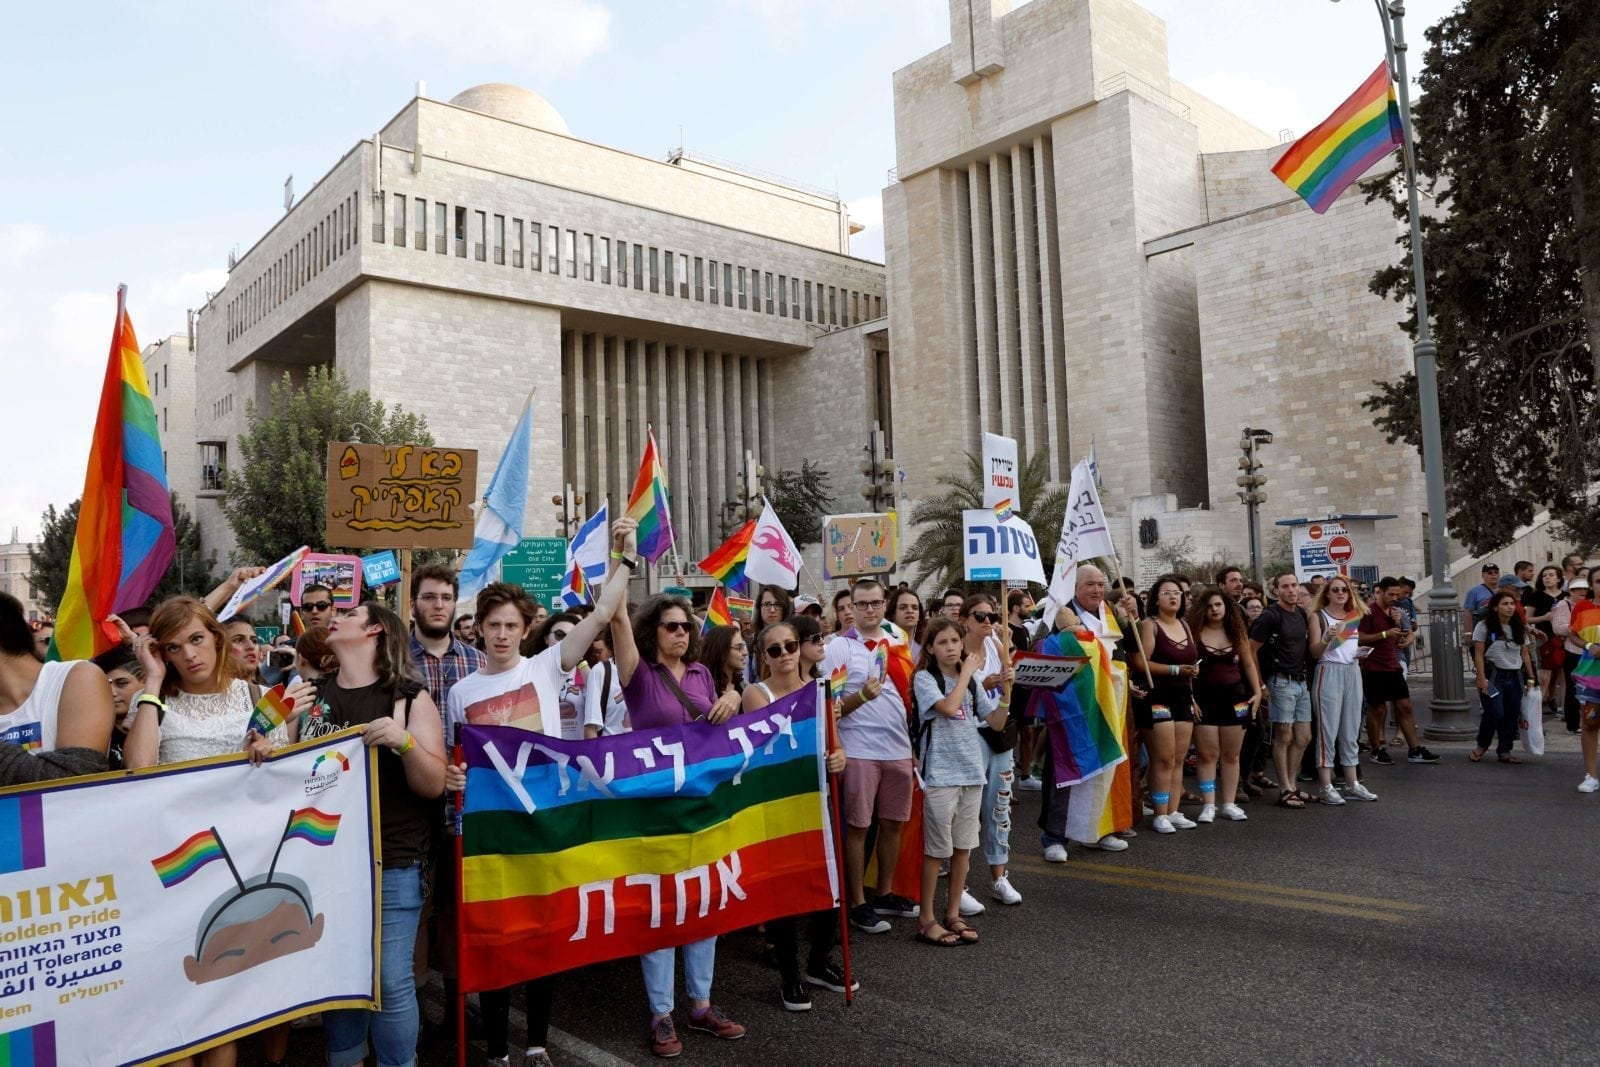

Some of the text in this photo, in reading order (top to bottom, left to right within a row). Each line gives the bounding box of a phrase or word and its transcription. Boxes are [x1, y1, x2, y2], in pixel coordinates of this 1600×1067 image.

[384, 445, 414, 478] לי
[991, 474, 1014, 489] עכשיו
[520, 541, 545, 549] העתיקה
[969, 525, 1037, 560] שווה
[1016, 664, 1075, 674] גאה להיות
[1017, 675, 1056, 683] שווה
[22, 728, 34, 737] אני
[483, 701, 798, 815] אין לי ארץ
[568, 850, 747, 941] אחרת
[68, 908, 121, 930] Pride
[71, 925, 121, 946] מצעד
[33, 943, 123, 972] Tolerance
[45, 959, 123, 988] مسيرة
[59, 979, 124, 1005] ירושלים
